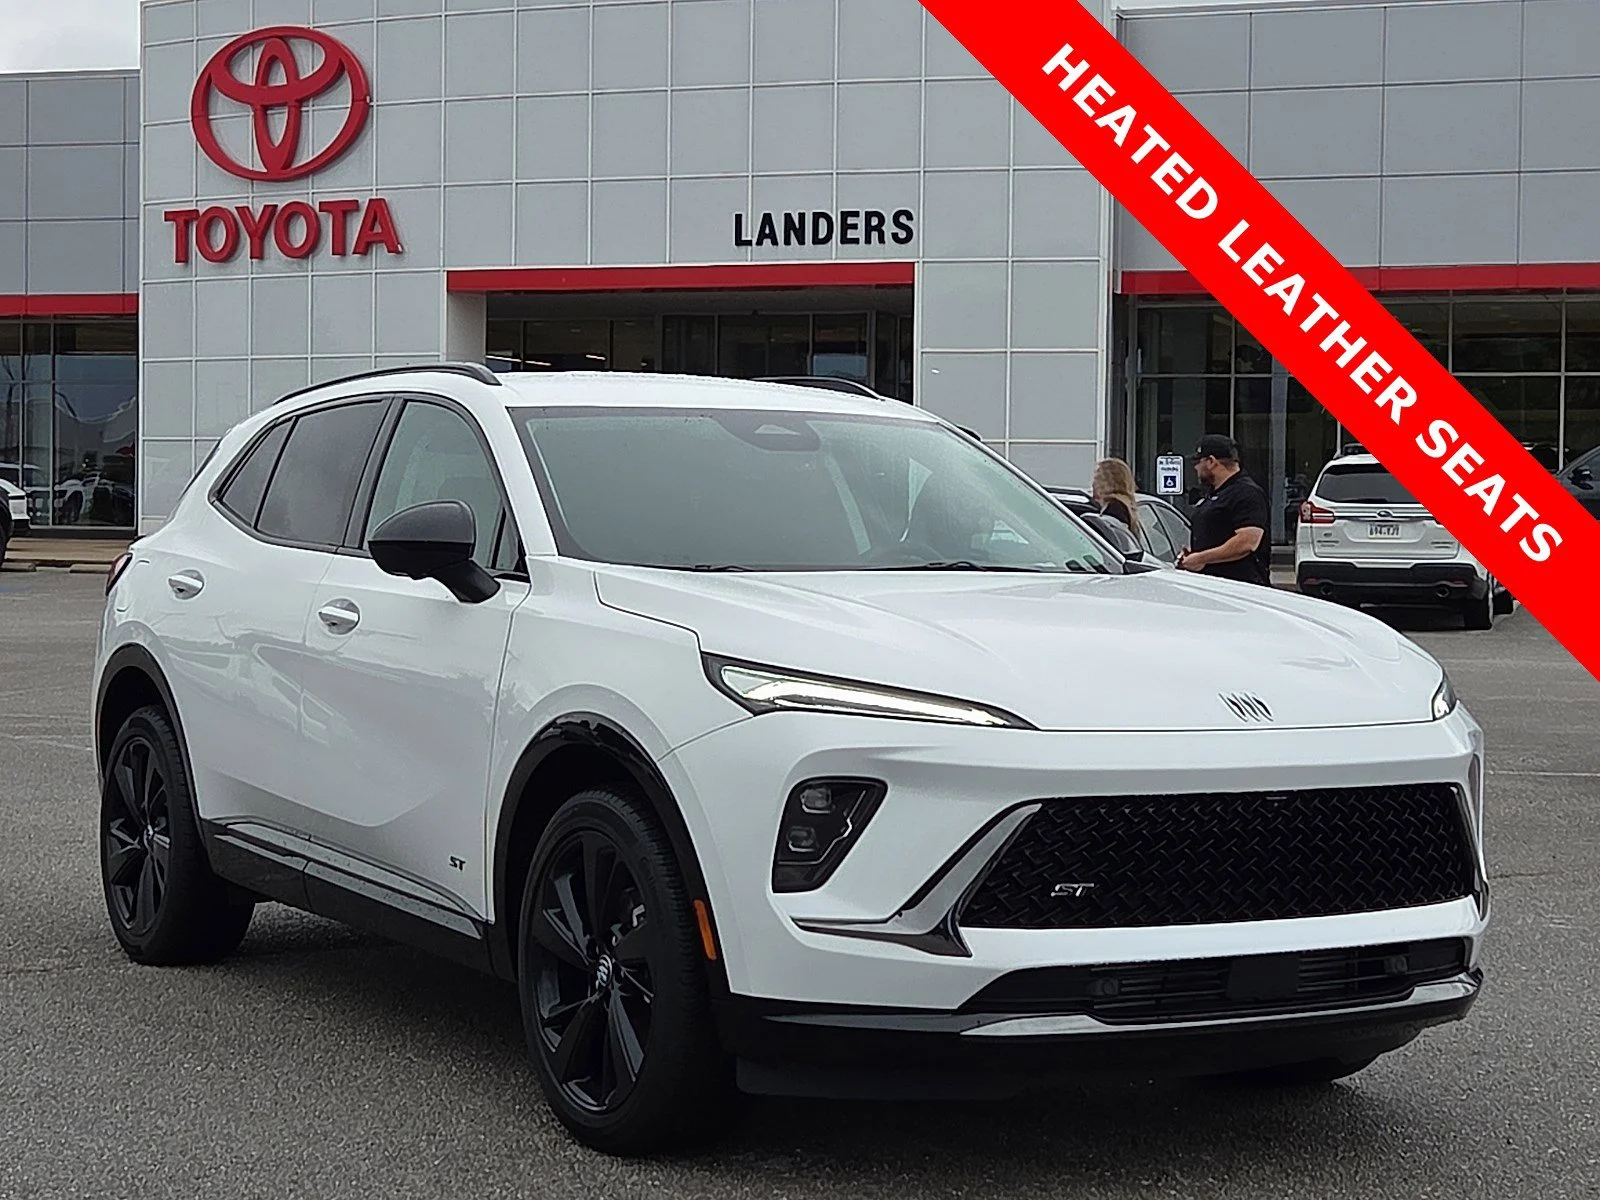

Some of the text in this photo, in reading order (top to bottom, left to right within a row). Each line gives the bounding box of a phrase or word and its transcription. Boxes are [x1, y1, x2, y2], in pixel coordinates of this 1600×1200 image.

[164, 197, 404, 264] TOYOTA
[734, 209, 914, 247] LANDERS
[449, 855, 466, 871] ST
[1050, 882, 1095, 897] ST
